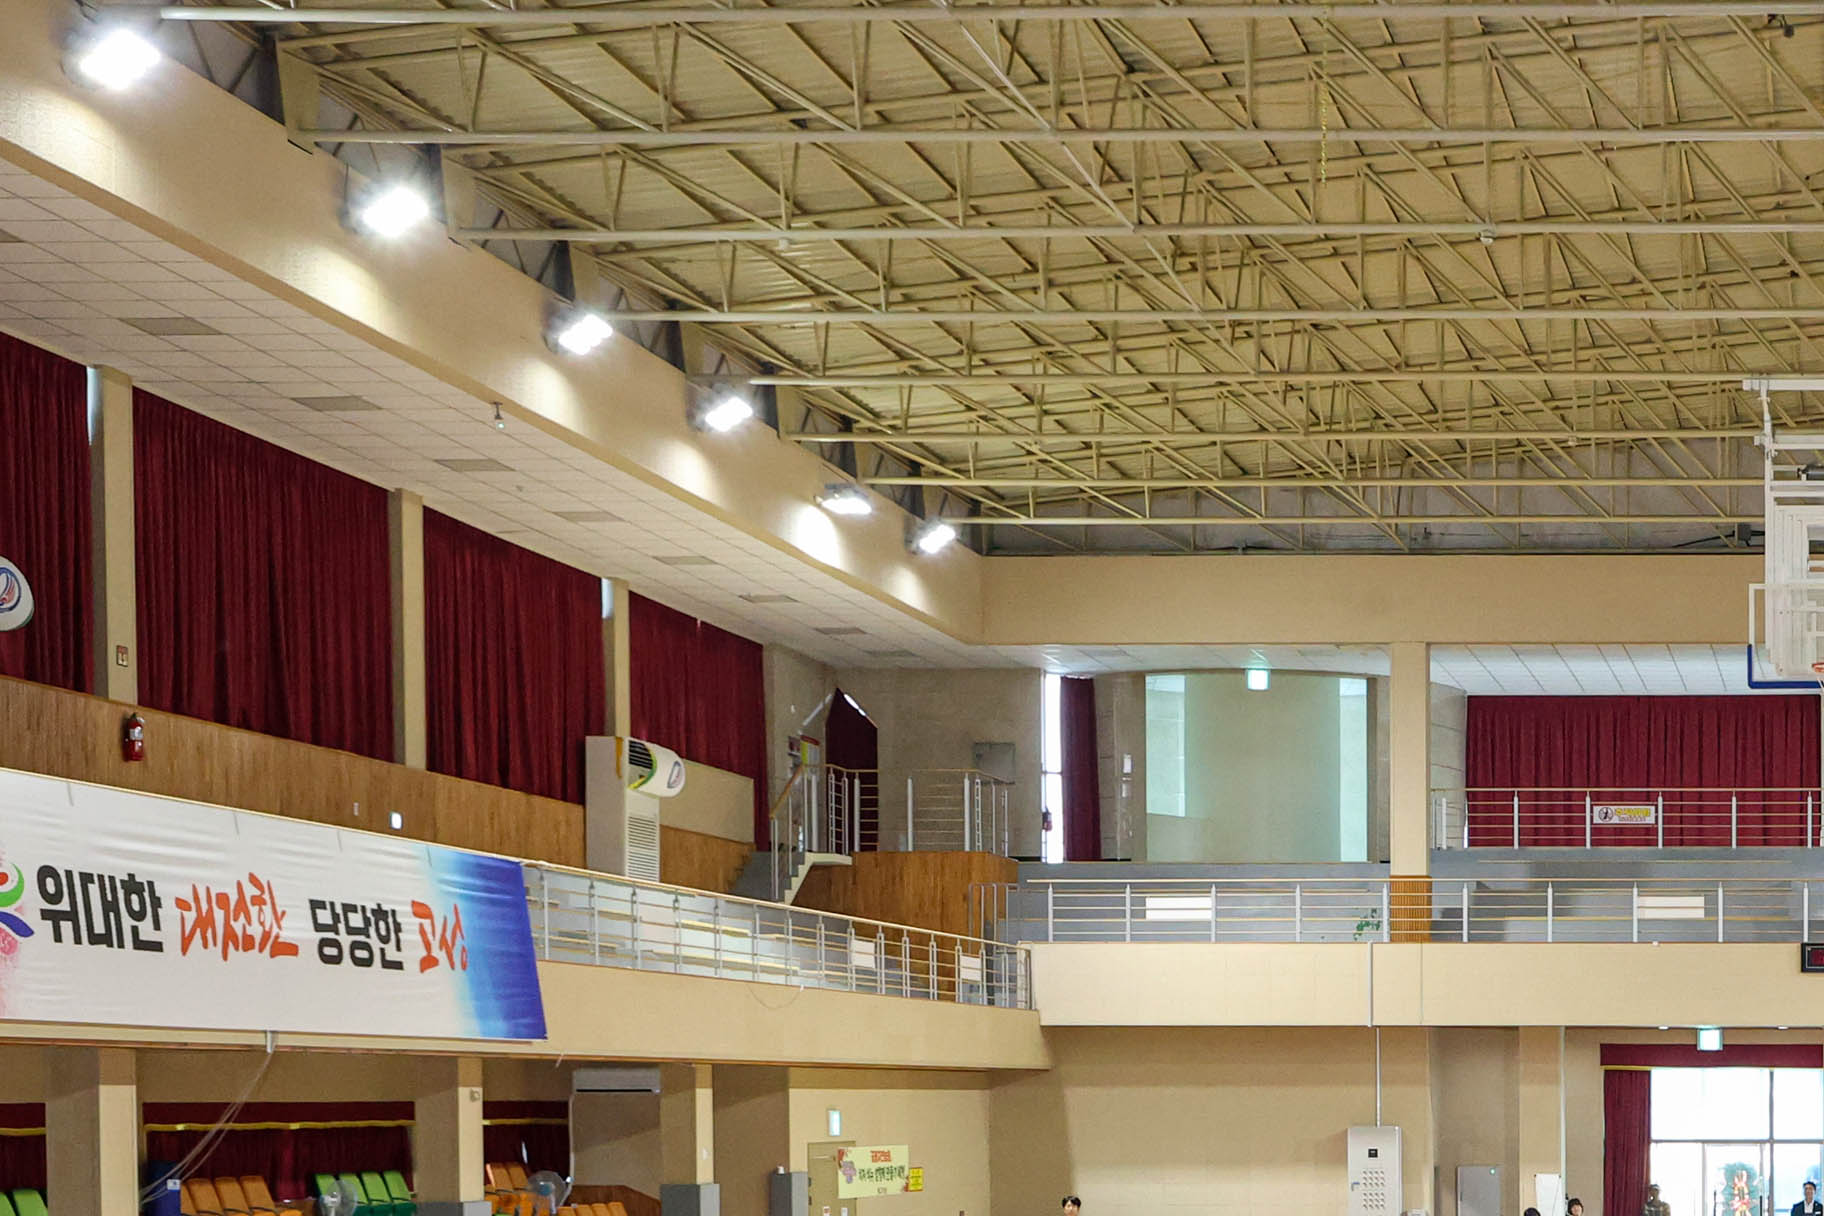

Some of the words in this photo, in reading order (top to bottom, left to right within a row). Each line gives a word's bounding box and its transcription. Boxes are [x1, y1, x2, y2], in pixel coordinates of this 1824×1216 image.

[37, 865, 163, 952] 위대한
[176, 873, 299, 961] 대전환
[309, 900, 403, 970] 당당한
[411, 900, 468, 973] 고성
